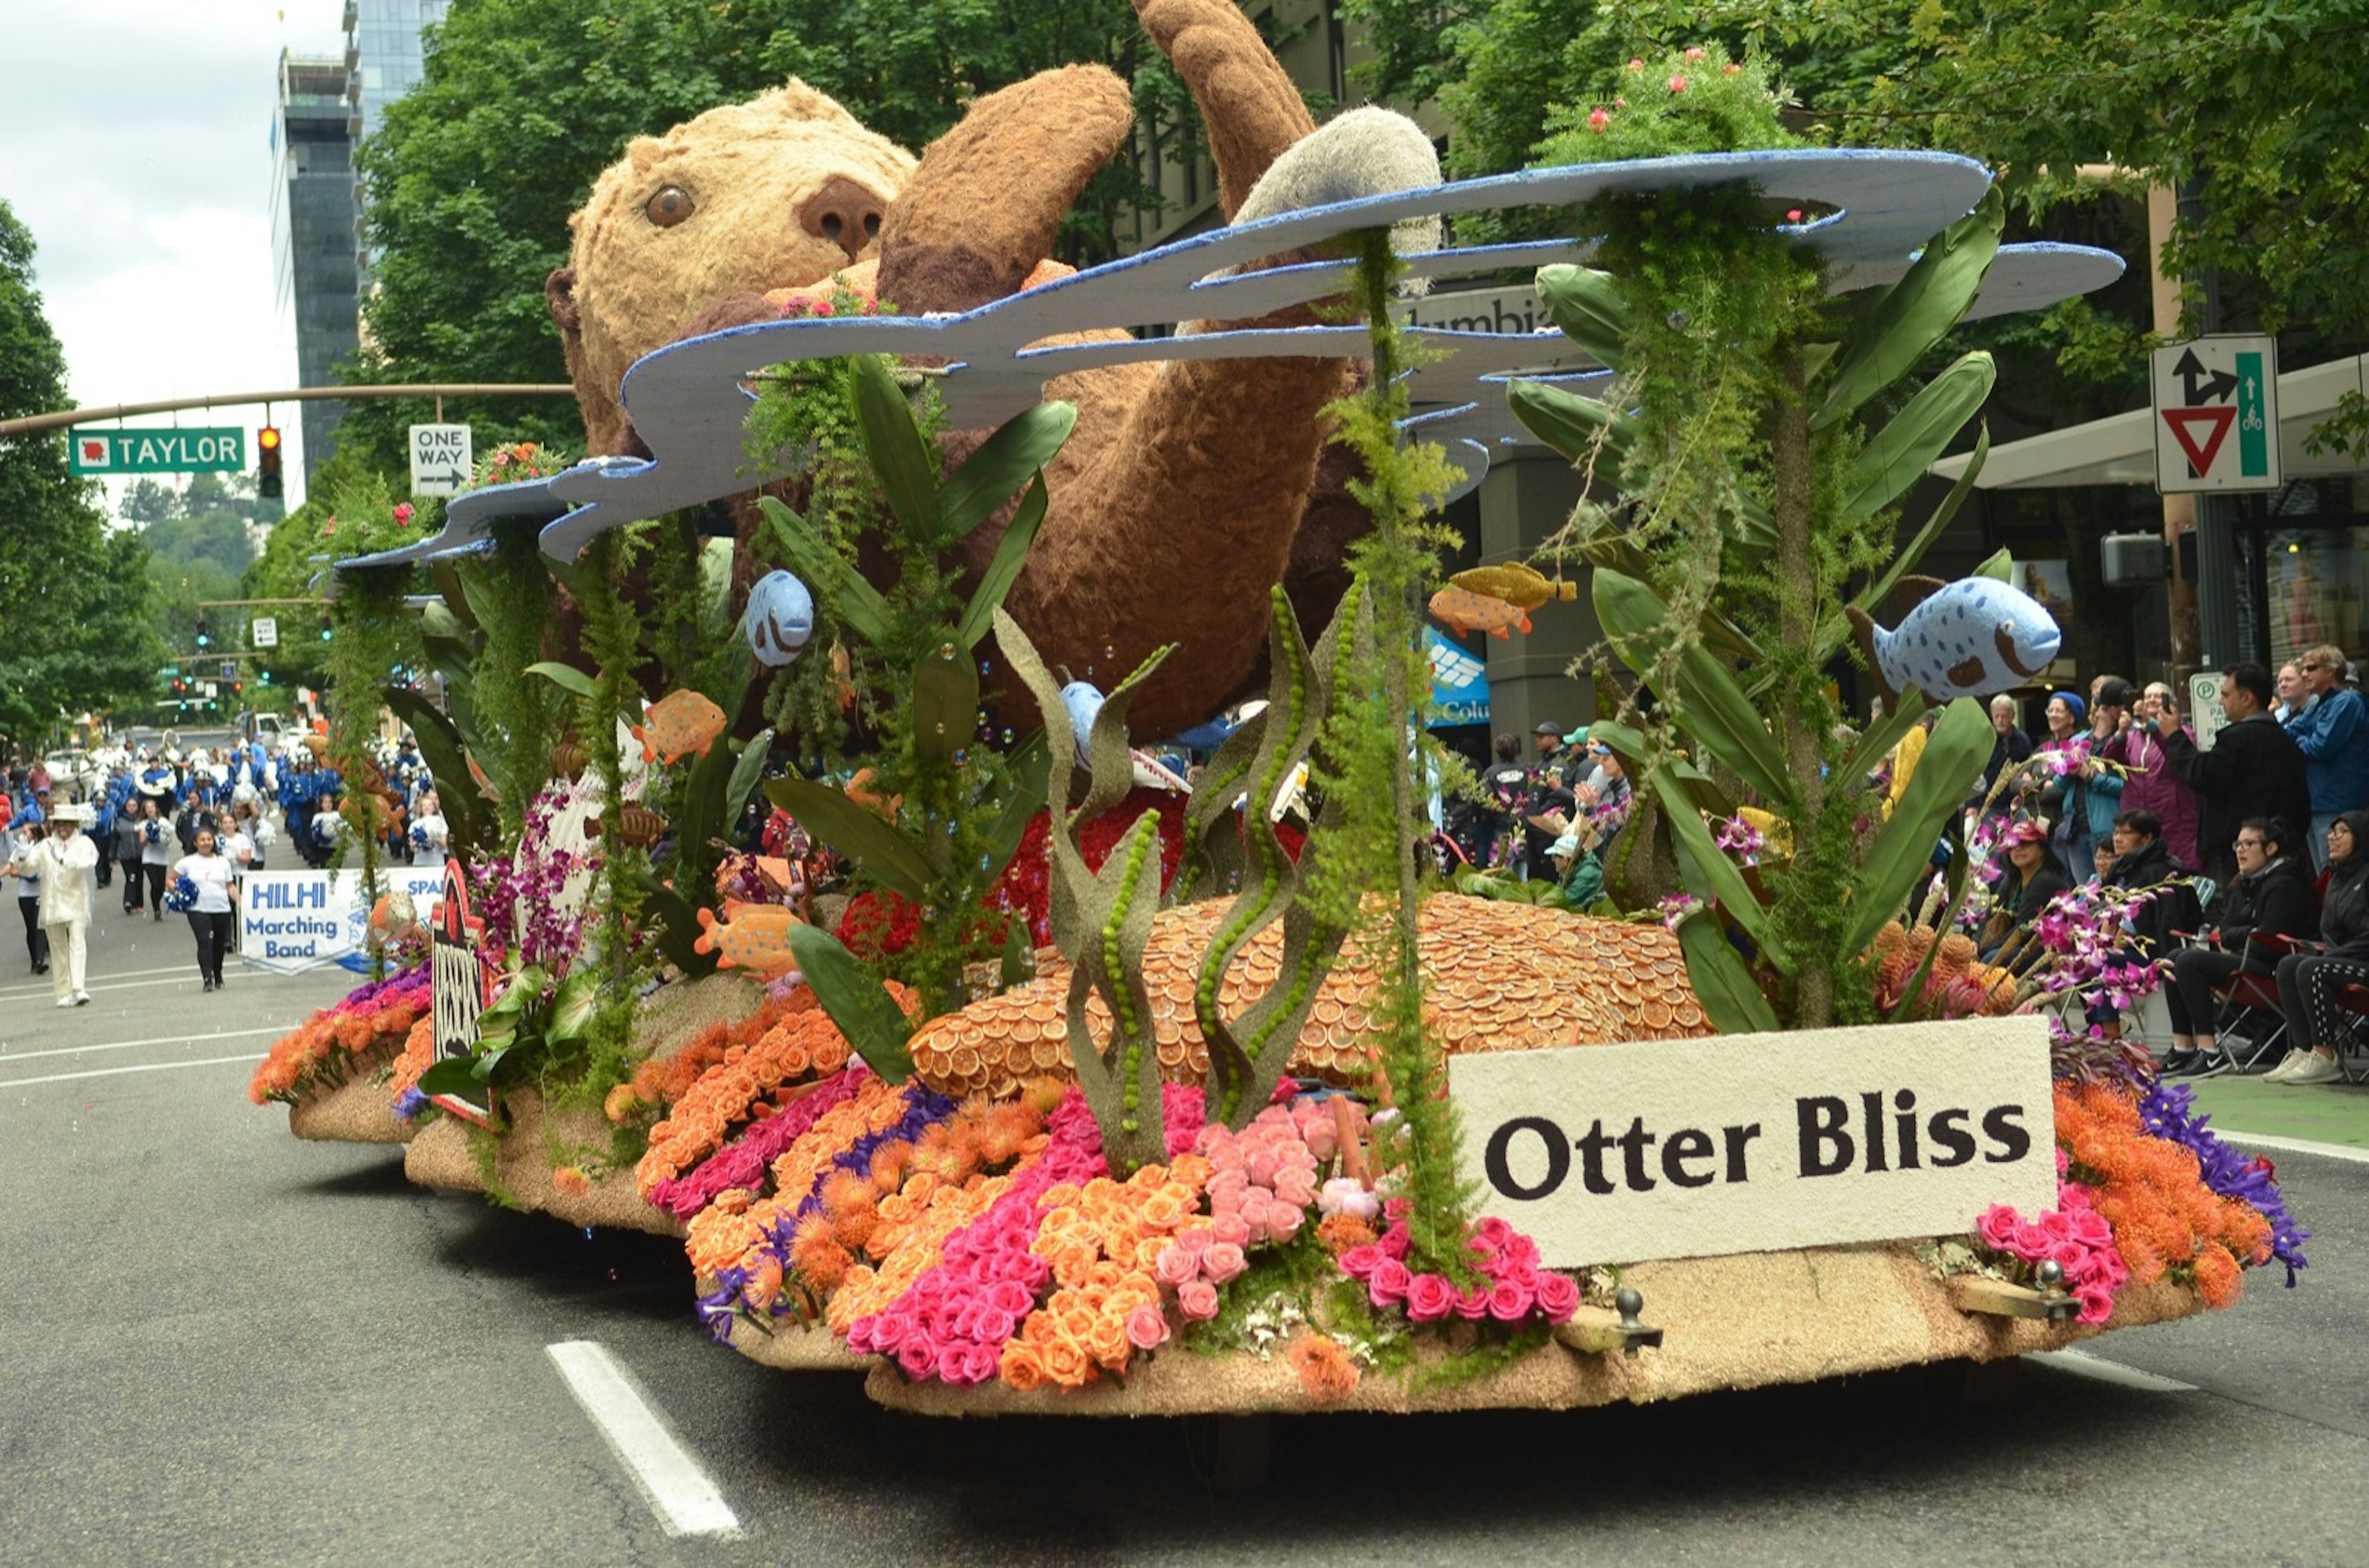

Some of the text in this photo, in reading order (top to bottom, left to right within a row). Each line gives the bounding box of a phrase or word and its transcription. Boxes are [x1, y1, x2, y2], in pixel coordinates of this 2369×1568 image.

[419, 431, 462, 447] ONE
[118, 437, 238, 464] TAYLOR
[418, 450, 463, 464] WAY
[1442, 700, 1490, 722] Colu
[2210, 708, 2223, 716] PA
[252, 881, 326, 909] HILHI
[246, 916, 337, 939] Marching
[265, 939, 316, 958] Band
[1484, 1088, 2031, 1202] Otter Bliss
